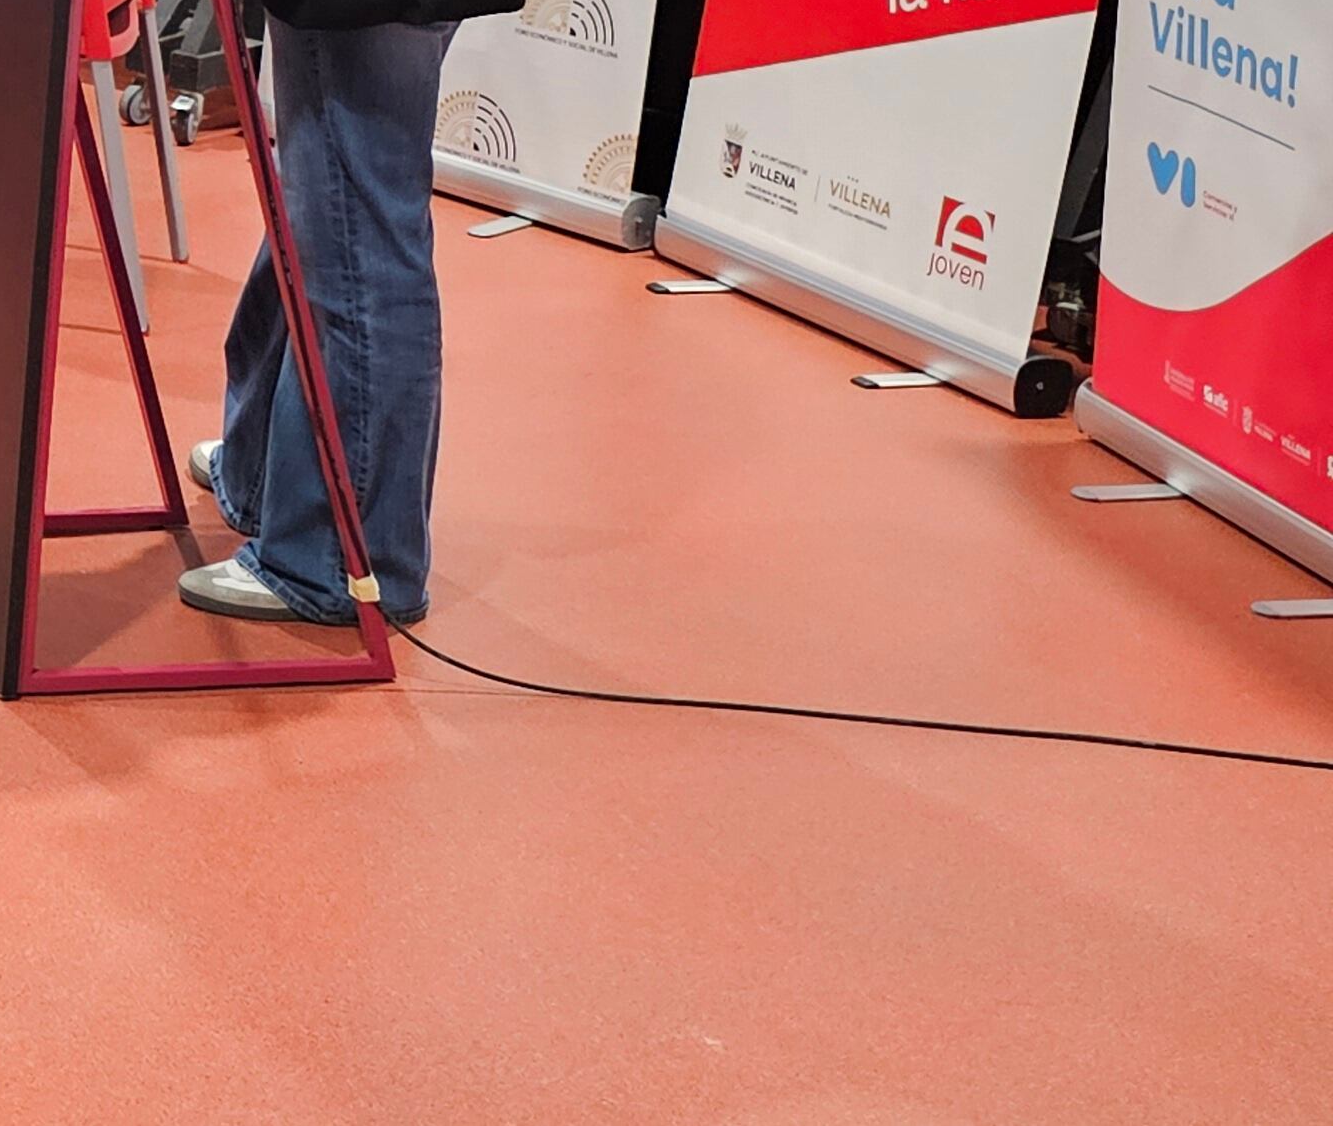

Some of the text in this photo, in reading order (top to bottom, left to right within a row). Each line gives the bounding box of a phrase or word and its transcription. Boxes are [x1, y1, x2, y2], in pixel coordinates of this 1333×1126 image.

[1149, 0, 1299, 109] Villena!
[749, 161, 796, 191] VILLENA
[830, 179, 891, 219] VILLENA
[927, 252, 985, 291] joven
